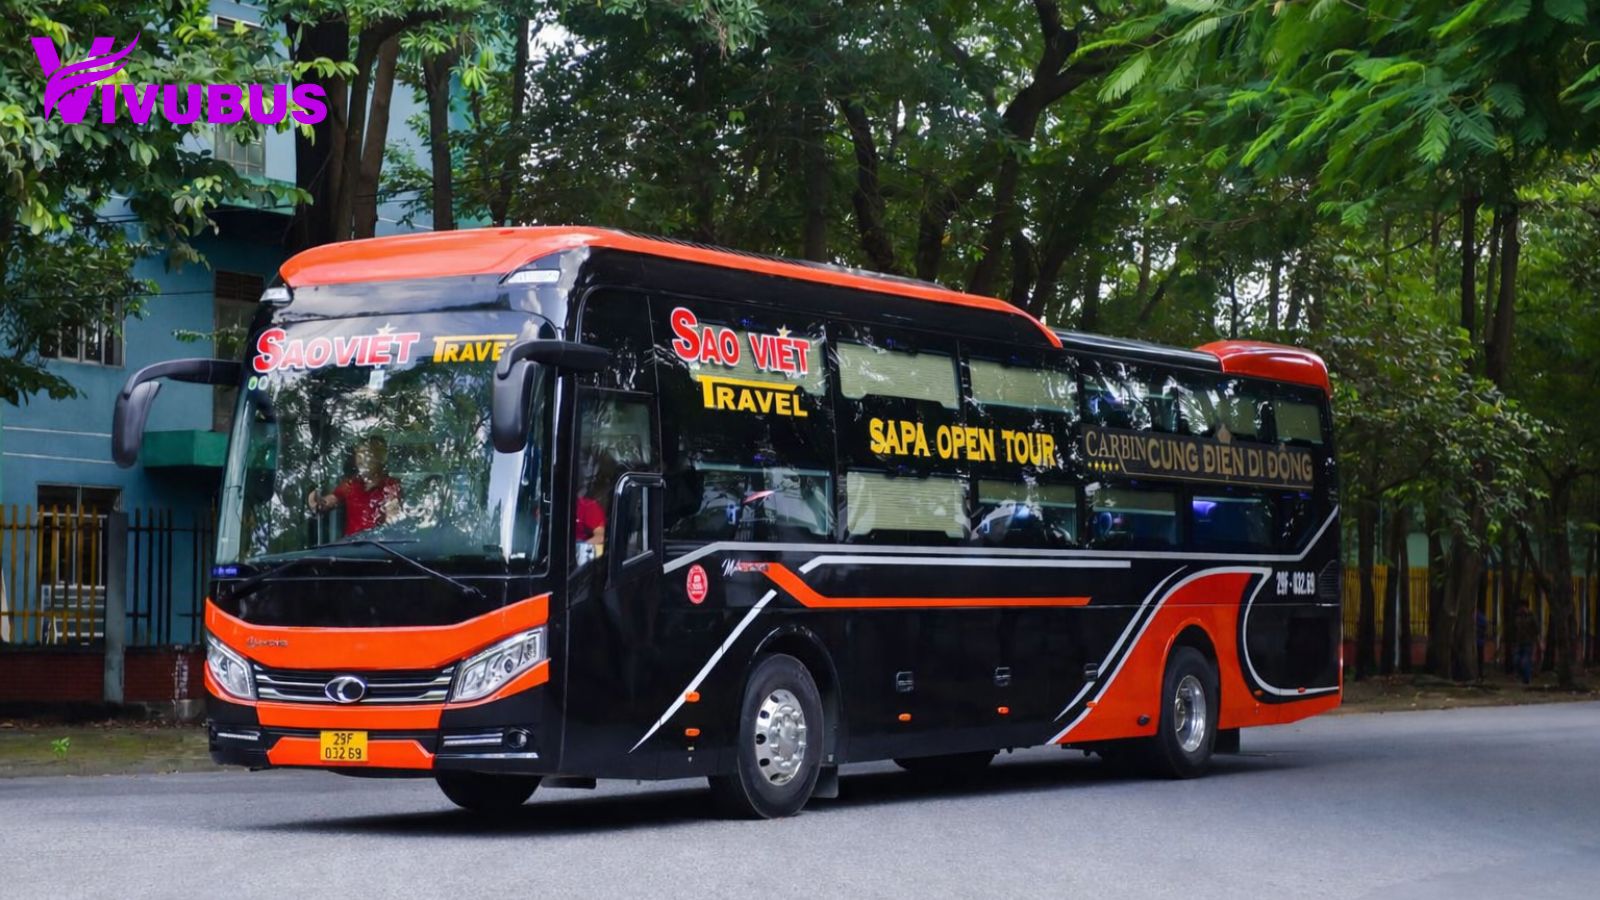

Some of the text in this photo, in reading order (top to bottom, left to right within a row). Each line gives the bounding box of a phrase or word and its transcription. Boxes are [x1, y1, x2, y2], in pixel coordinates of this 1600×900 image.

[432, 334, 518, 363] TRAVE
[670, 307, 740, 366] SAO
[697, 374, 808, 417] TRAVEL
[869, 417, 1057, 467] SAPA OPEN TOUR
[1148, 438, 1199, 473] CUNG
[1247, 447, 1265, 477] DI
